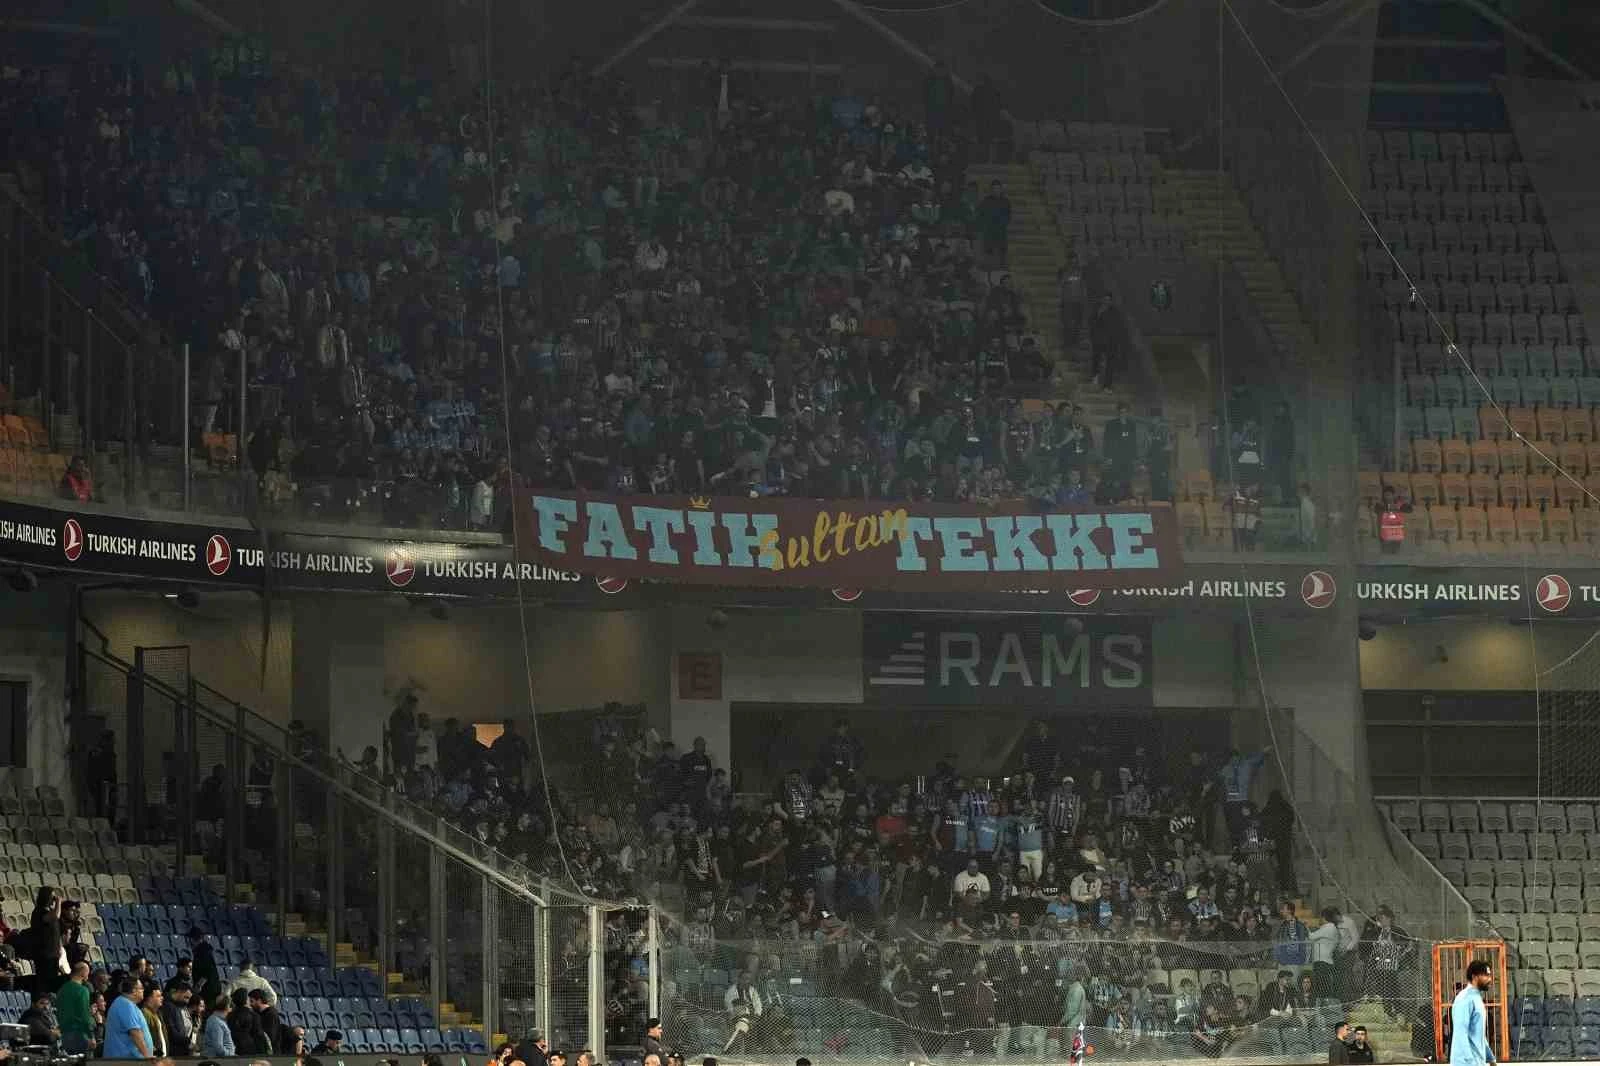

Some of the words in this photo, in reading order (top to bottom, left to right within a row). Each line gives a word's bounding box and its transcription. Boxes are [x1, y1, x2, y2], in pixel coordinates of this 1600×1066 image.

[0, 519, 14, 540] ISH
[16, 523, 56, 546] AIRLINES
[530, 494, 778, 569] FATIH
[878, 513, 1159, 572] TEKKE
[87, 533, 136, 556] TURKISH
[139, 539, 196, 562] AIRLINES
[304, 553, 373, 574] AIRLINES
[423, 561, 497, 579] TURKISH
[1199, 579, 1287, 598] AIRLINES
[1356, 583, 1429, 600] URKISH
[1434, 584, 1521, 601] AIRLINES
[938, 631, 1143, 689] RAMS
